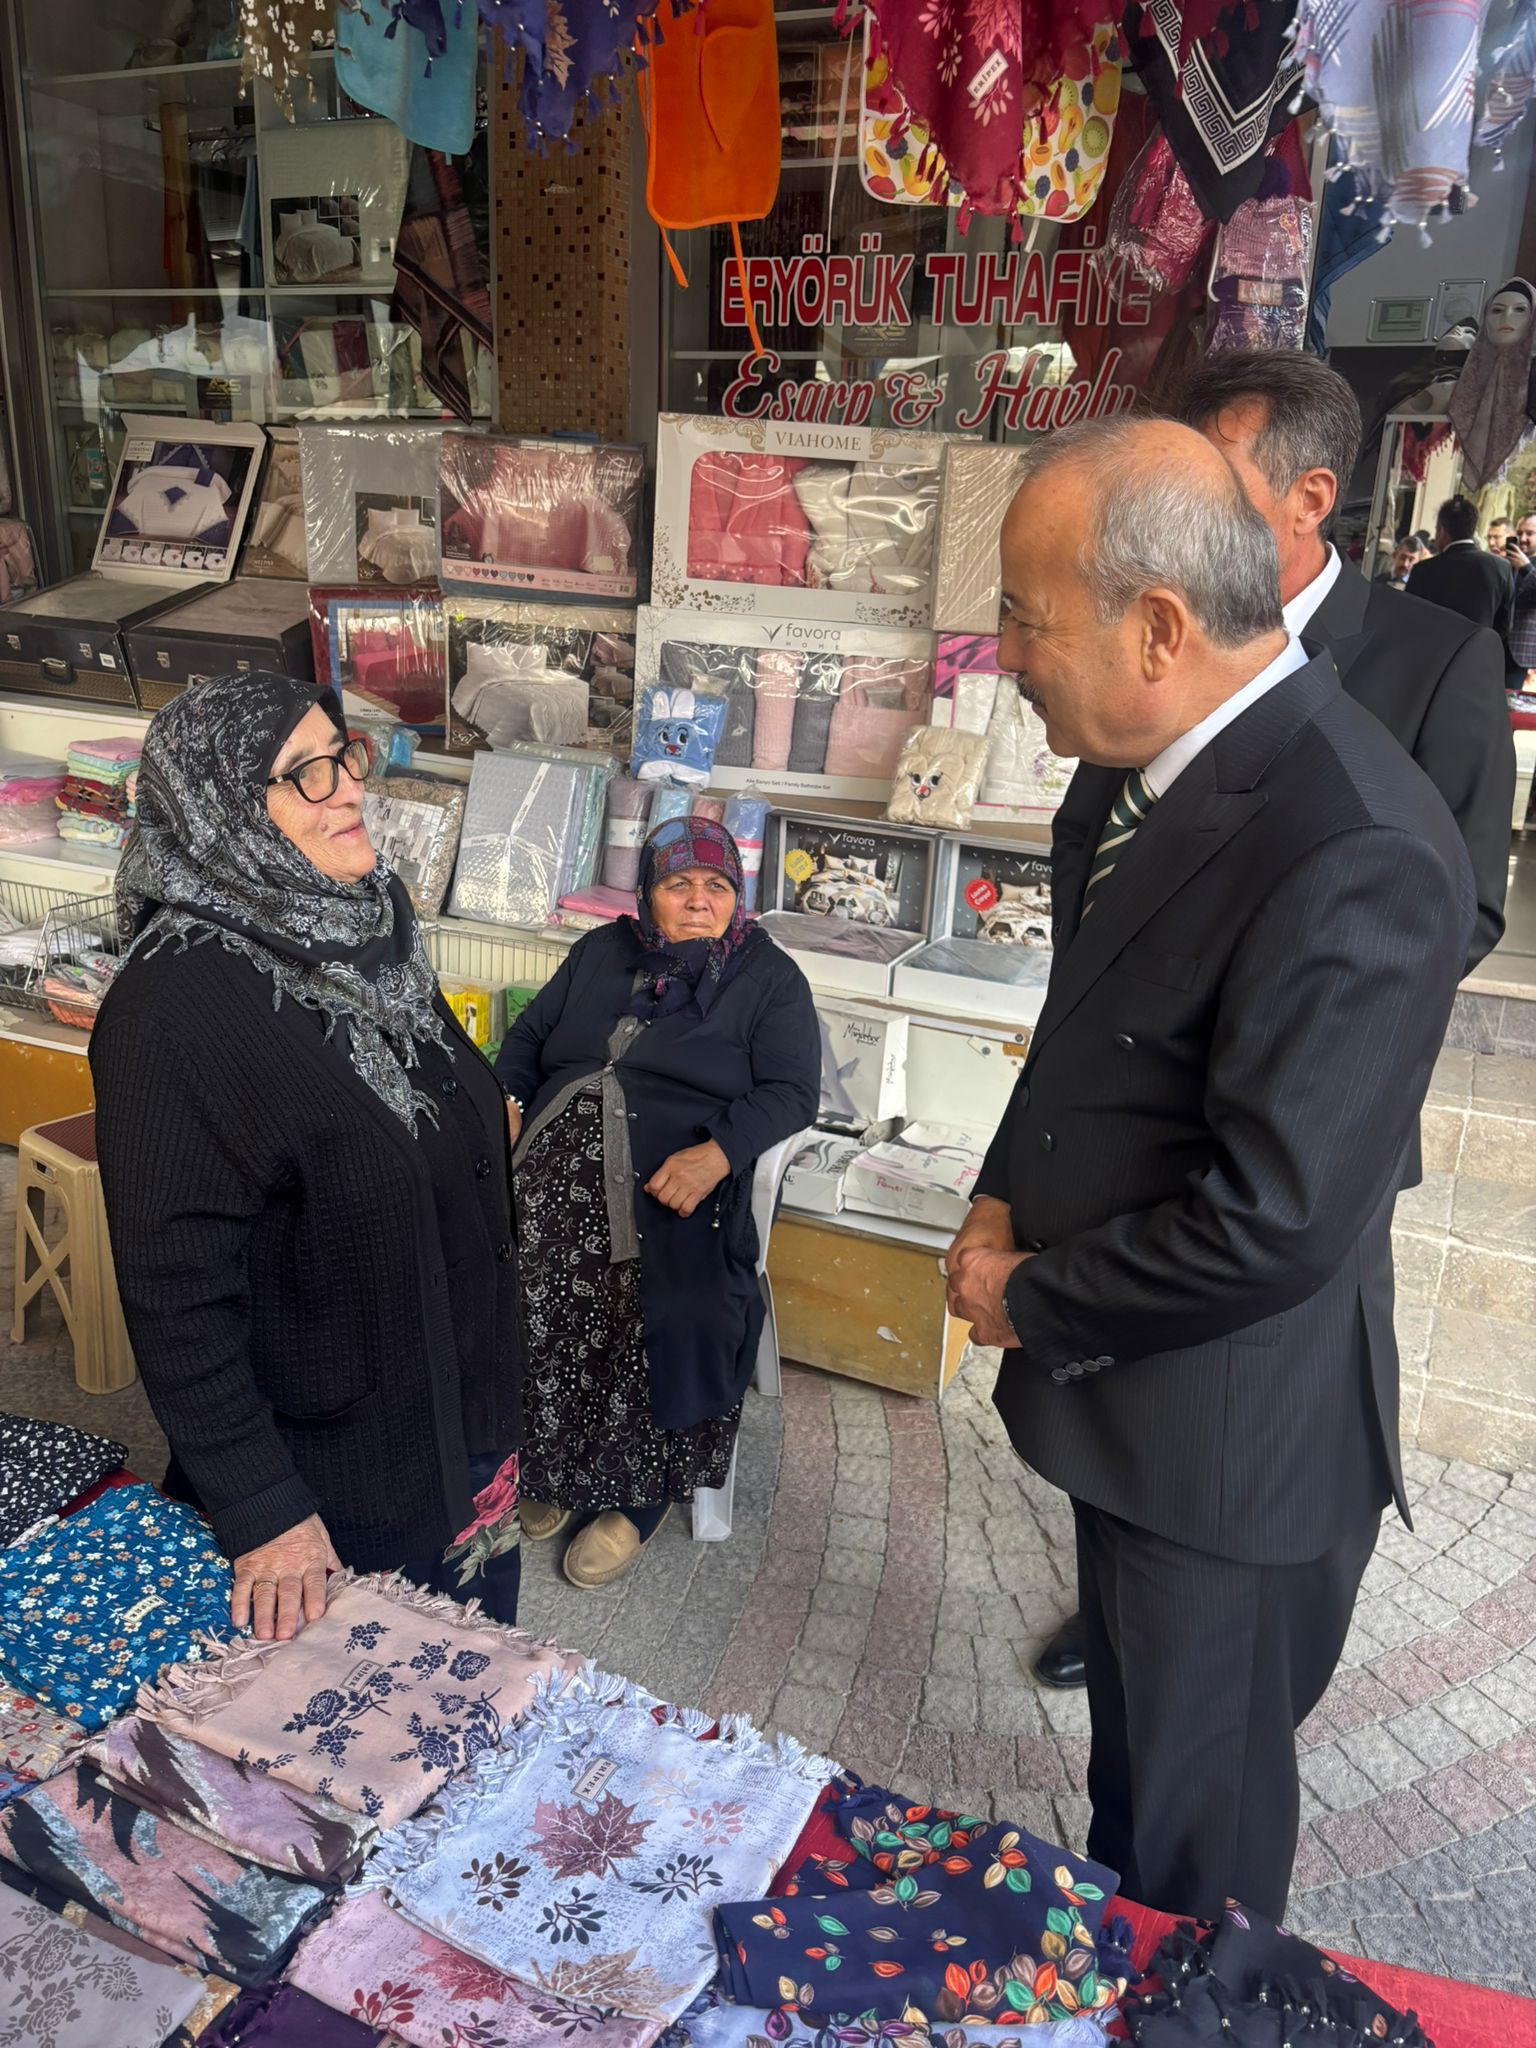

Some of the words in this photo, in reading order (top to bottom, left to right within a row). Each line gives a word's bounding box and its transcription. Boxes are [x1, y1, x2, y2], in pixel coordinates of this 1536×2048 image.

[721, 232, 915, 327] ERYÖRÜK
[925, 225, 1153, 327] TUHAFİYE
[884, 371, 944, 428] &
[776, 431, 862, 451] VIAHOME
[785, 623, 841, 641] favora
[842, 832, 876, 847] favora
